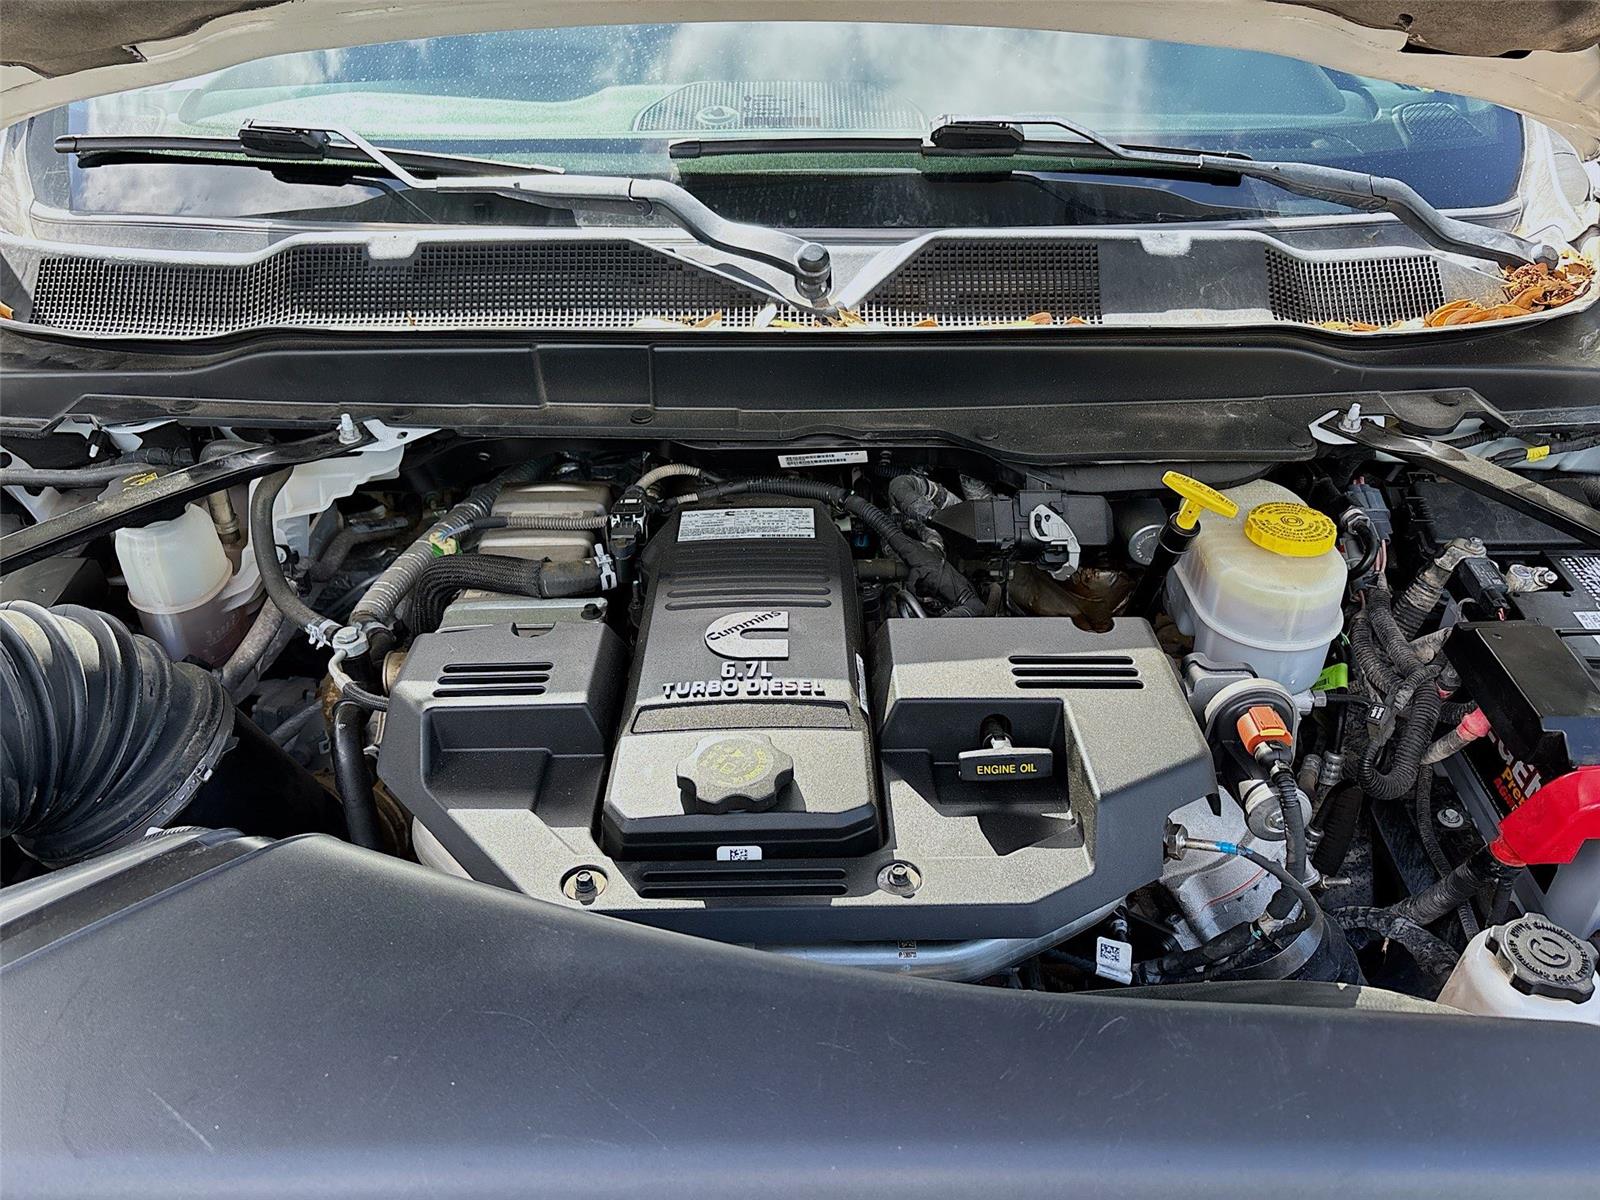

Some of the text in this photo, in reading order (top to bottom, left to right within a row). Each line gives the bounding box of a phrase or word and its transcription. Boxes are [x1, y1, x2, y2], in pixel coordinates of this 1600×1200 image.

[706, 611, 782, 641] Cummins
[721, 661, 773, 680] 6.7L
[663, 679, 826, 698] TURBO DIESEL
[976, 763, 1037, 775] ENGINE OIL
